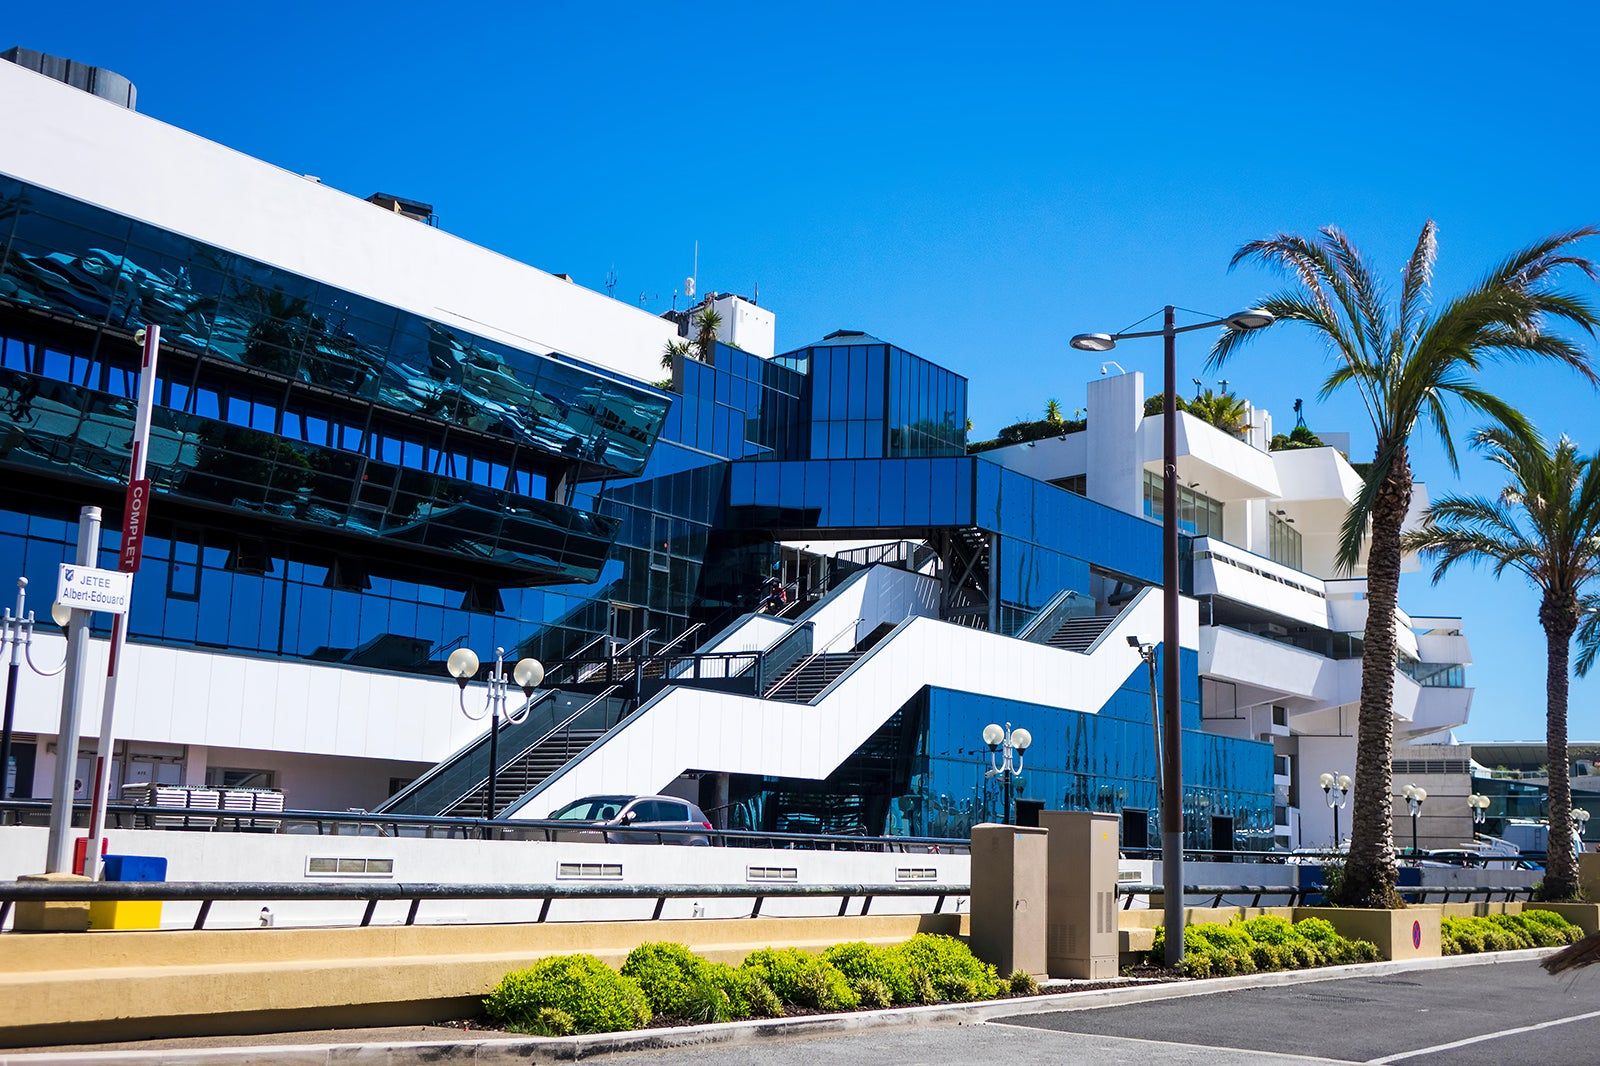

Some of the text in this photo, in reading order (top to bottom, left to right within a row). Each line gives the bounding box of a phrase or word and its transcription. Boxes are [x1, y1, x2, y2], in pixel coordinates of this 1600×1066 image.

[125, 486, 143, 567] COMPLET
[80, 575, 111, 588] JETEE
[63, 587, 125, 605] Albert-Edouard
